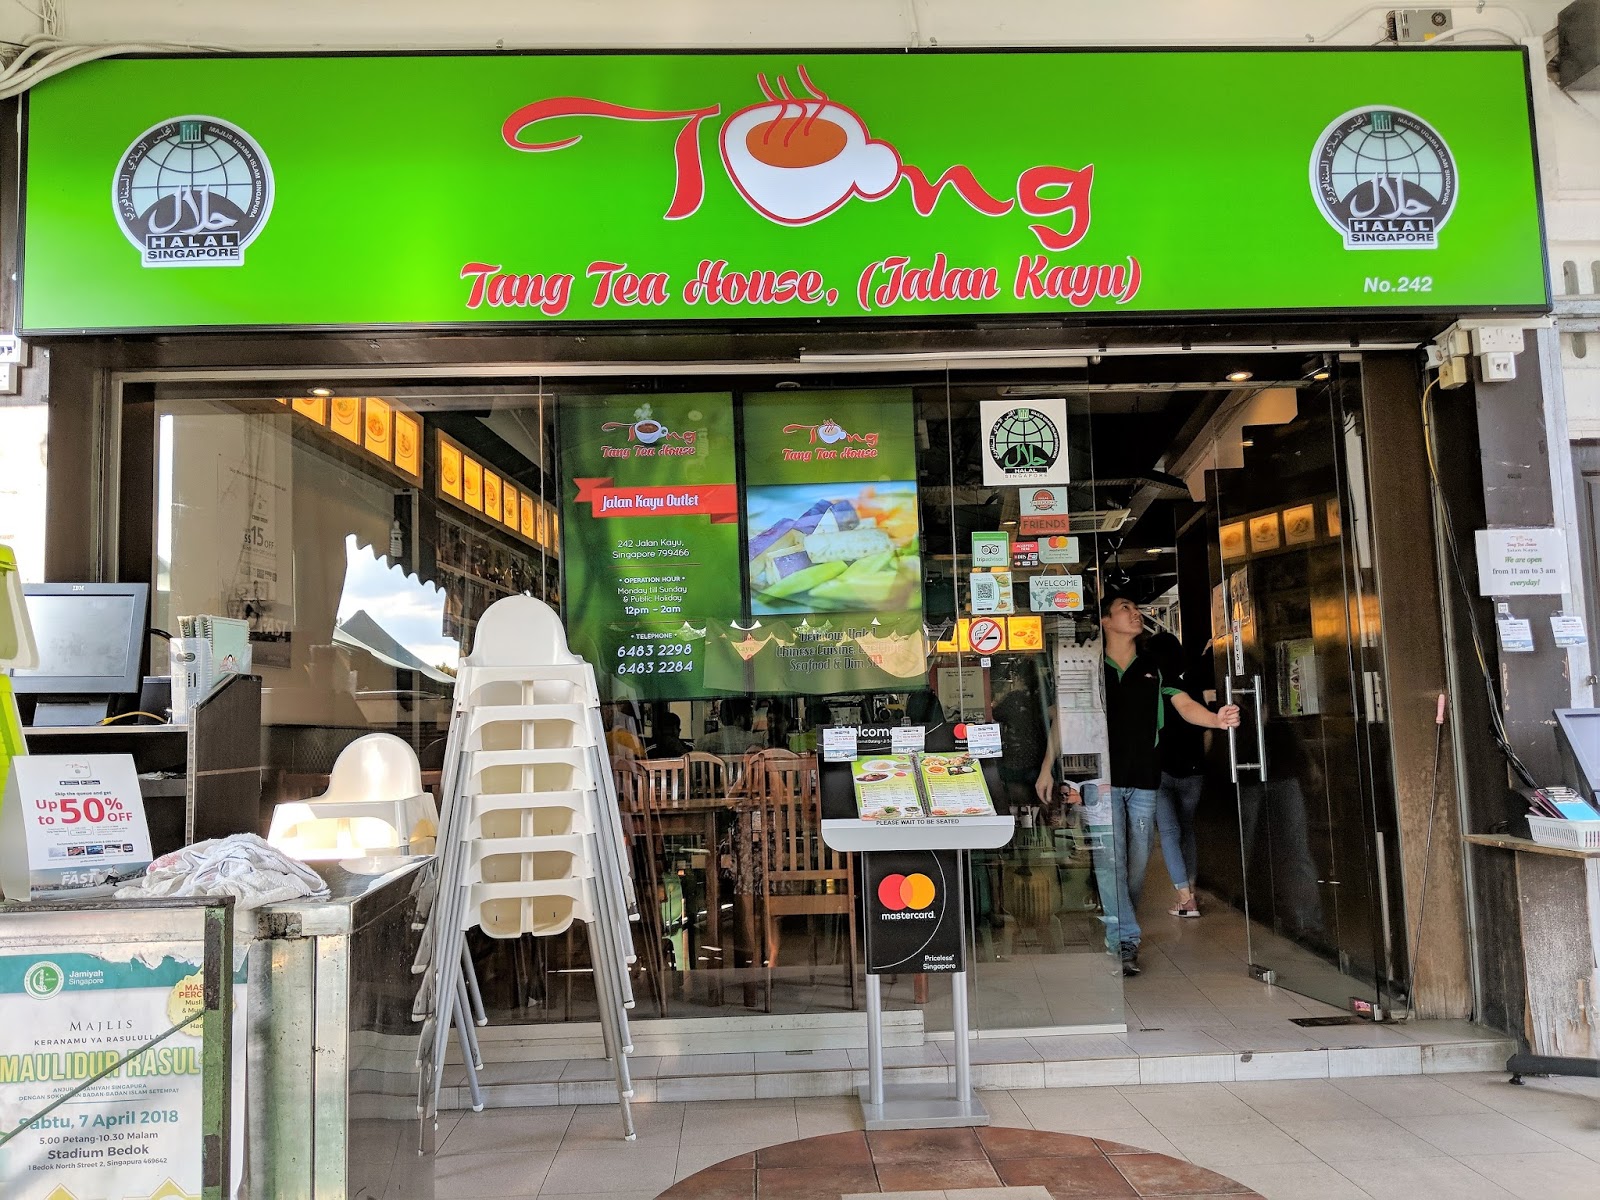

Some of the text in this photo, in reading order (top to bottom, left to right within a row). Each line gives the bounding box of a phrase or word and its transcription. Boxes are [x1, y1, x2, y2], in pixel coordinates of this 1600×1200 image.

[1397, 116, 1451, 206] MAJLIS UGAMA ISLAM SINGAPURA
[209, 126, 262, 219] MAJLIS UGAMA ISLAM SINGAPURA
[1353, 221, 1430, 232] HALAL
[151, 236, 234, 249] HALAL
[1351, 233, 1434, 242] SINGAPORE
[147, 249, 239, 260] SINGAPORE
[461, 252, 1143, 316] Tang Tea House, (Jalan Kayu)
[1363, 276, 1433, 293] No.242
[600, 443, 696, 459] Tang Tea House
[782, 446, 878, 462] Tang Tea House
[600, 493, 699, 512] Jalan Kayu Outlet
[1023, 519, 1067, 530] FRIENDS
[617, 538, 684, 548] 242 Jalan Kayu,
[612, 549, 690, 560] Singapore 799466
[1526, 556, 1542, 564] open
[1034, 579, 1078, 587] WELCOME
[1509, 579, 1541, 587] everyday!
[617, 586, 688, 596] Monday till Sunday
[630, 595, 653, 604] Public
[654, 594, 683, 604] Holiday
[624, 604, 681, 616] 12pm 2am
[617, 643, 693, 658] 6483 2298
[776, 645, 816, 658] Chinese
[617, 660, 694, 675] 6483 2284
[790, 659, 832, 674] Seafood
[833, 658, 841, 669] &
[844, 657, 864, 670] Dim
[854, 725, 893, 737] lcom
[36, 797, 133, 826] Up to 50% OFF
[61, 872, 97, 886] FAST
[922, 963, 956, 971] Singapore
[69, 970, 104, 978] Jamiyah
[68, 978, 104, 986] Singapore
[69, 1019, 133, 1032] MAJLIS
[34, 1037, 87, 1046] KERANAMU
[106, 1034, 167, 1043] RASULULLA
[0, 1046, 201, 1084] MAULIDUR RASUL
[18, 1094, 46, 1102] DENGAN
[82, 1090, 129, 1099] BADAN-BADAN
[148, 1087, 180, 1095] SETEMPAT
[79, 1114, 90, 1128] 7
[92, 1110, 136, 1130] April
[140, 1109, 179, 1124] 2018
[39, 1130, 159, 1145] 5.00 Petang-10.30 Malam
[47, 1144, 150, 1160] Stadium Bedok
[32, 1163, 55, 1171] Bedok
[55, 1162, 76, 1170] North
[106, 1159, 143, 1167] Singapura
